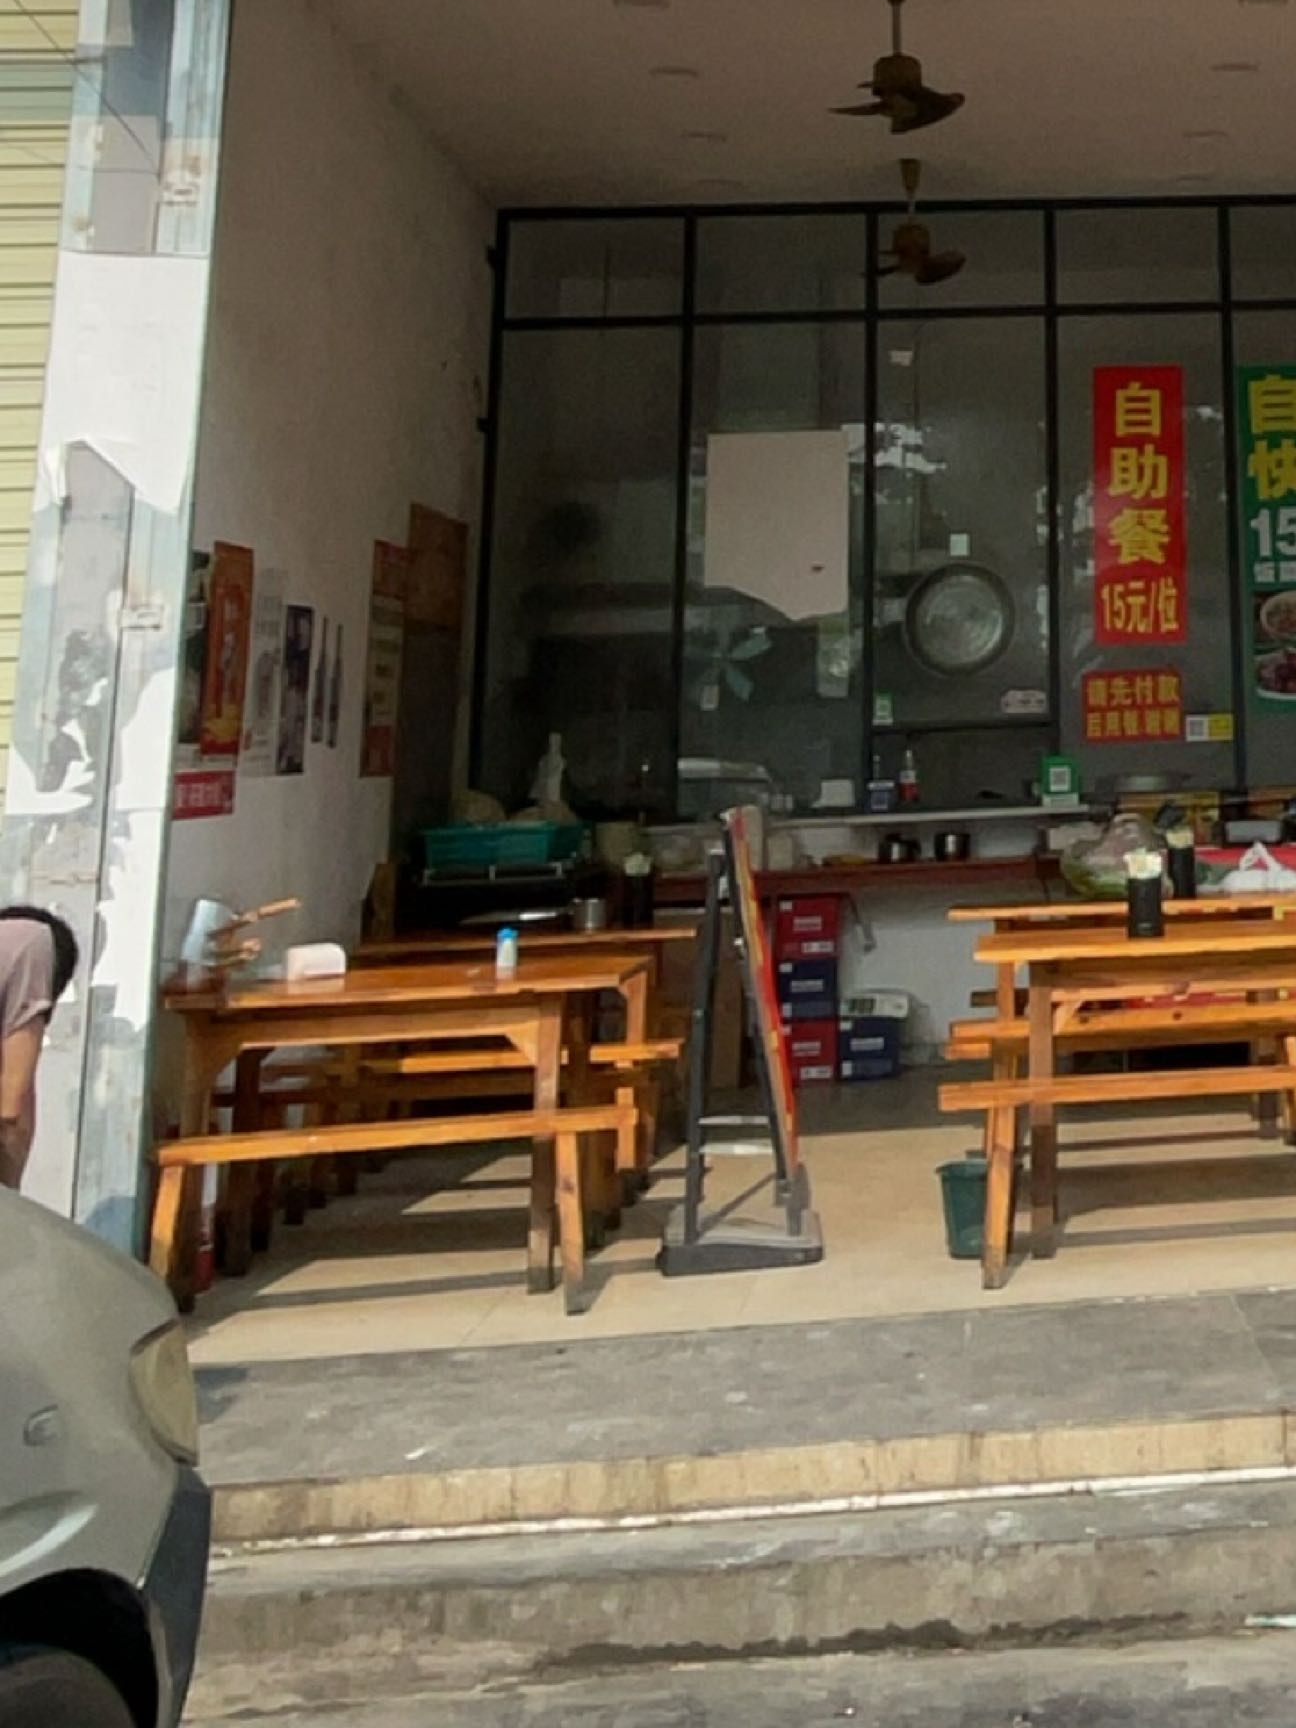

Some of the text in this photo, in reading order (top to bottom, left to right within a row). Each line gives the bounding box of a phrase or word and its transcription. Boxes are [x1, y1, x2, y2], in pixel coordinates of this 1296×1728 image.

[1109, 382, 1169, 564] 自助餐
[1102, 577, 1179, 635] 15元/位
